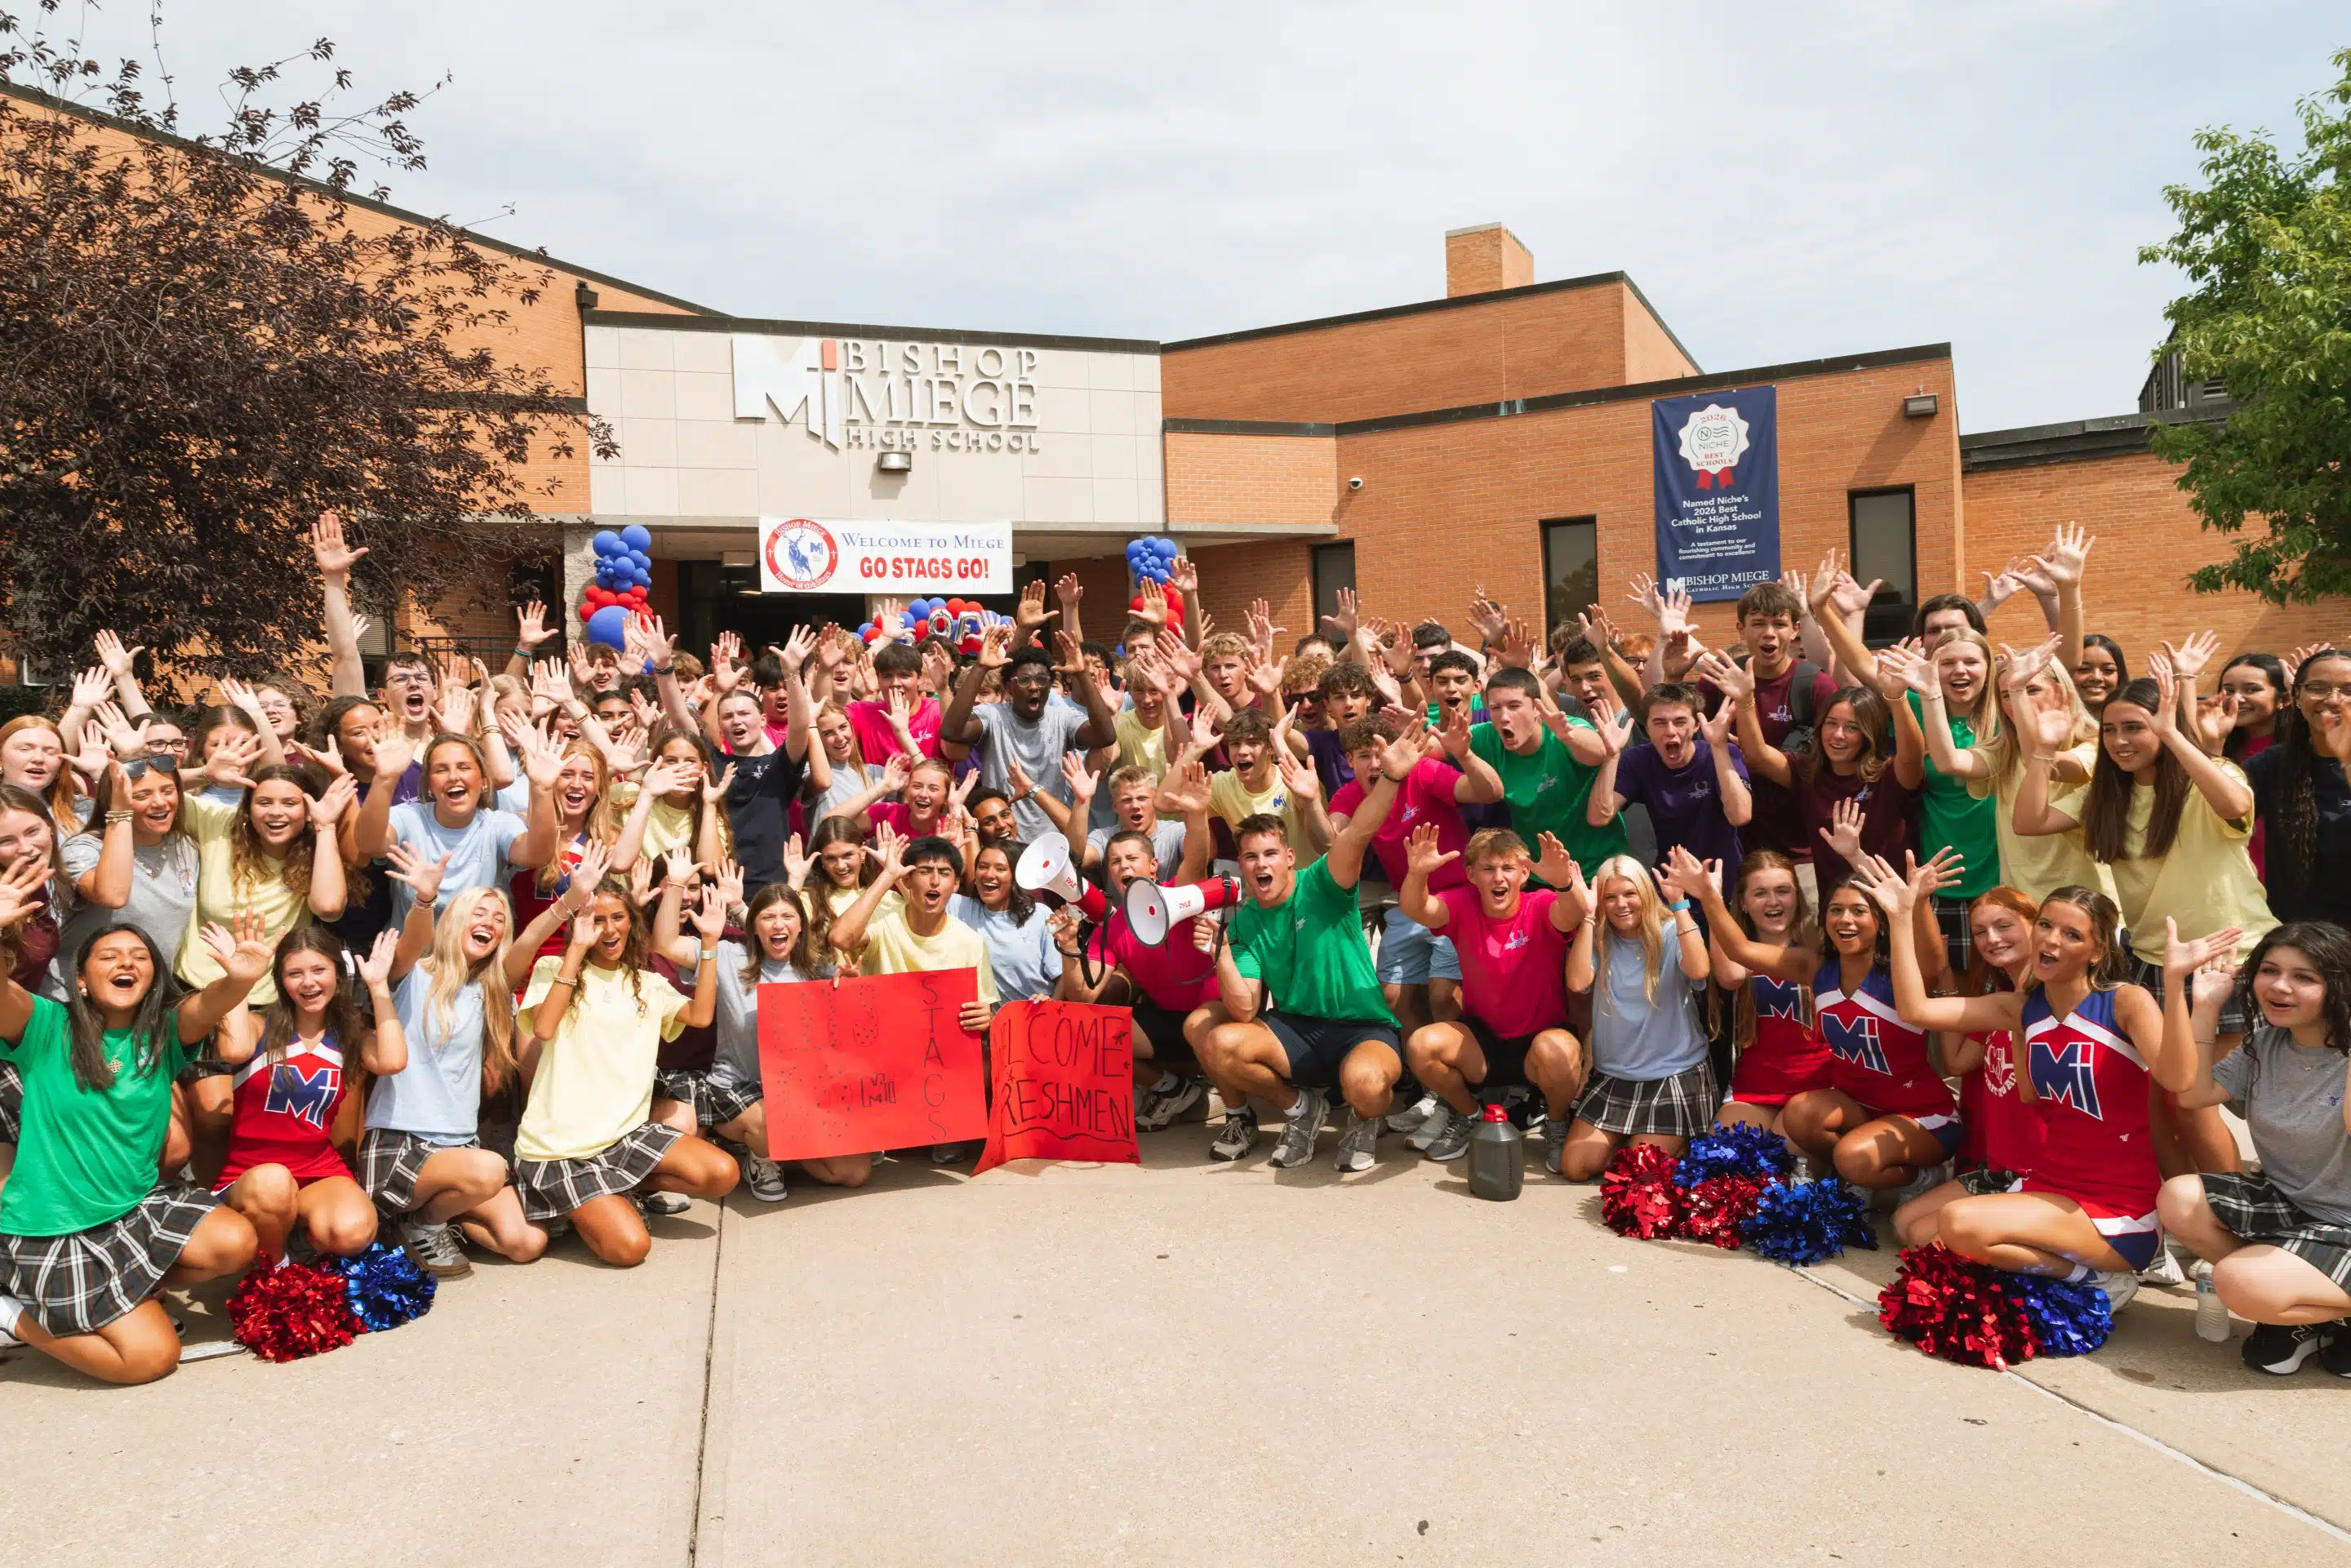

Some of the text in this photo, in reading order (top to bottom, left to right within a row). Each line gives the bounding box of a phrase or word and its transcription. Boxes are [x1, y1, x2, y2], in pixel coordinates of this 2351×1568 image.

[843, 341, 1038, 378] BISHOP
[845, 372, 1041, 427] MIEGE
[1700, 413, 1727, 424] 2026
[847, 427, 1040, 451] HIGH SCHOOL
[1699, 441, 1730, 451] NICHE
[1696, 458, 1734, 468] SCHOOLS
[1682, 494, 1749, 508] Named Niche's
[1671, 510, 1762, 526] Catholic High School
[1694, 505, 1738, 516] 2026 Best
[775, 521, 827, 536] BISHOP MIEGE
[1695, 524, 1737, 534] in Kansas
[841, 532, 1004, 549] WELCOME TO MIEGE
[1678, 547, 1709, 555] flourishing
[1710, 544, 1744, 552] community
[860, 557, 989, 579] GO STAGS GO!
[776, 571, 795, 587] Home
[804, 580, 816, 589] the
[815, 571, 832, 586] Stags
[1686, 574, 1728, 586] BISHOP
[1731, 571, 1770, 583] MIEGE
[1065, 877, 1077, 889] PYLE
[1179, 899, 1192, 908] PYLE
[921, 975, 948, 1141] STAGS
[993, 1078, 1130, 1139] RESHMEN
